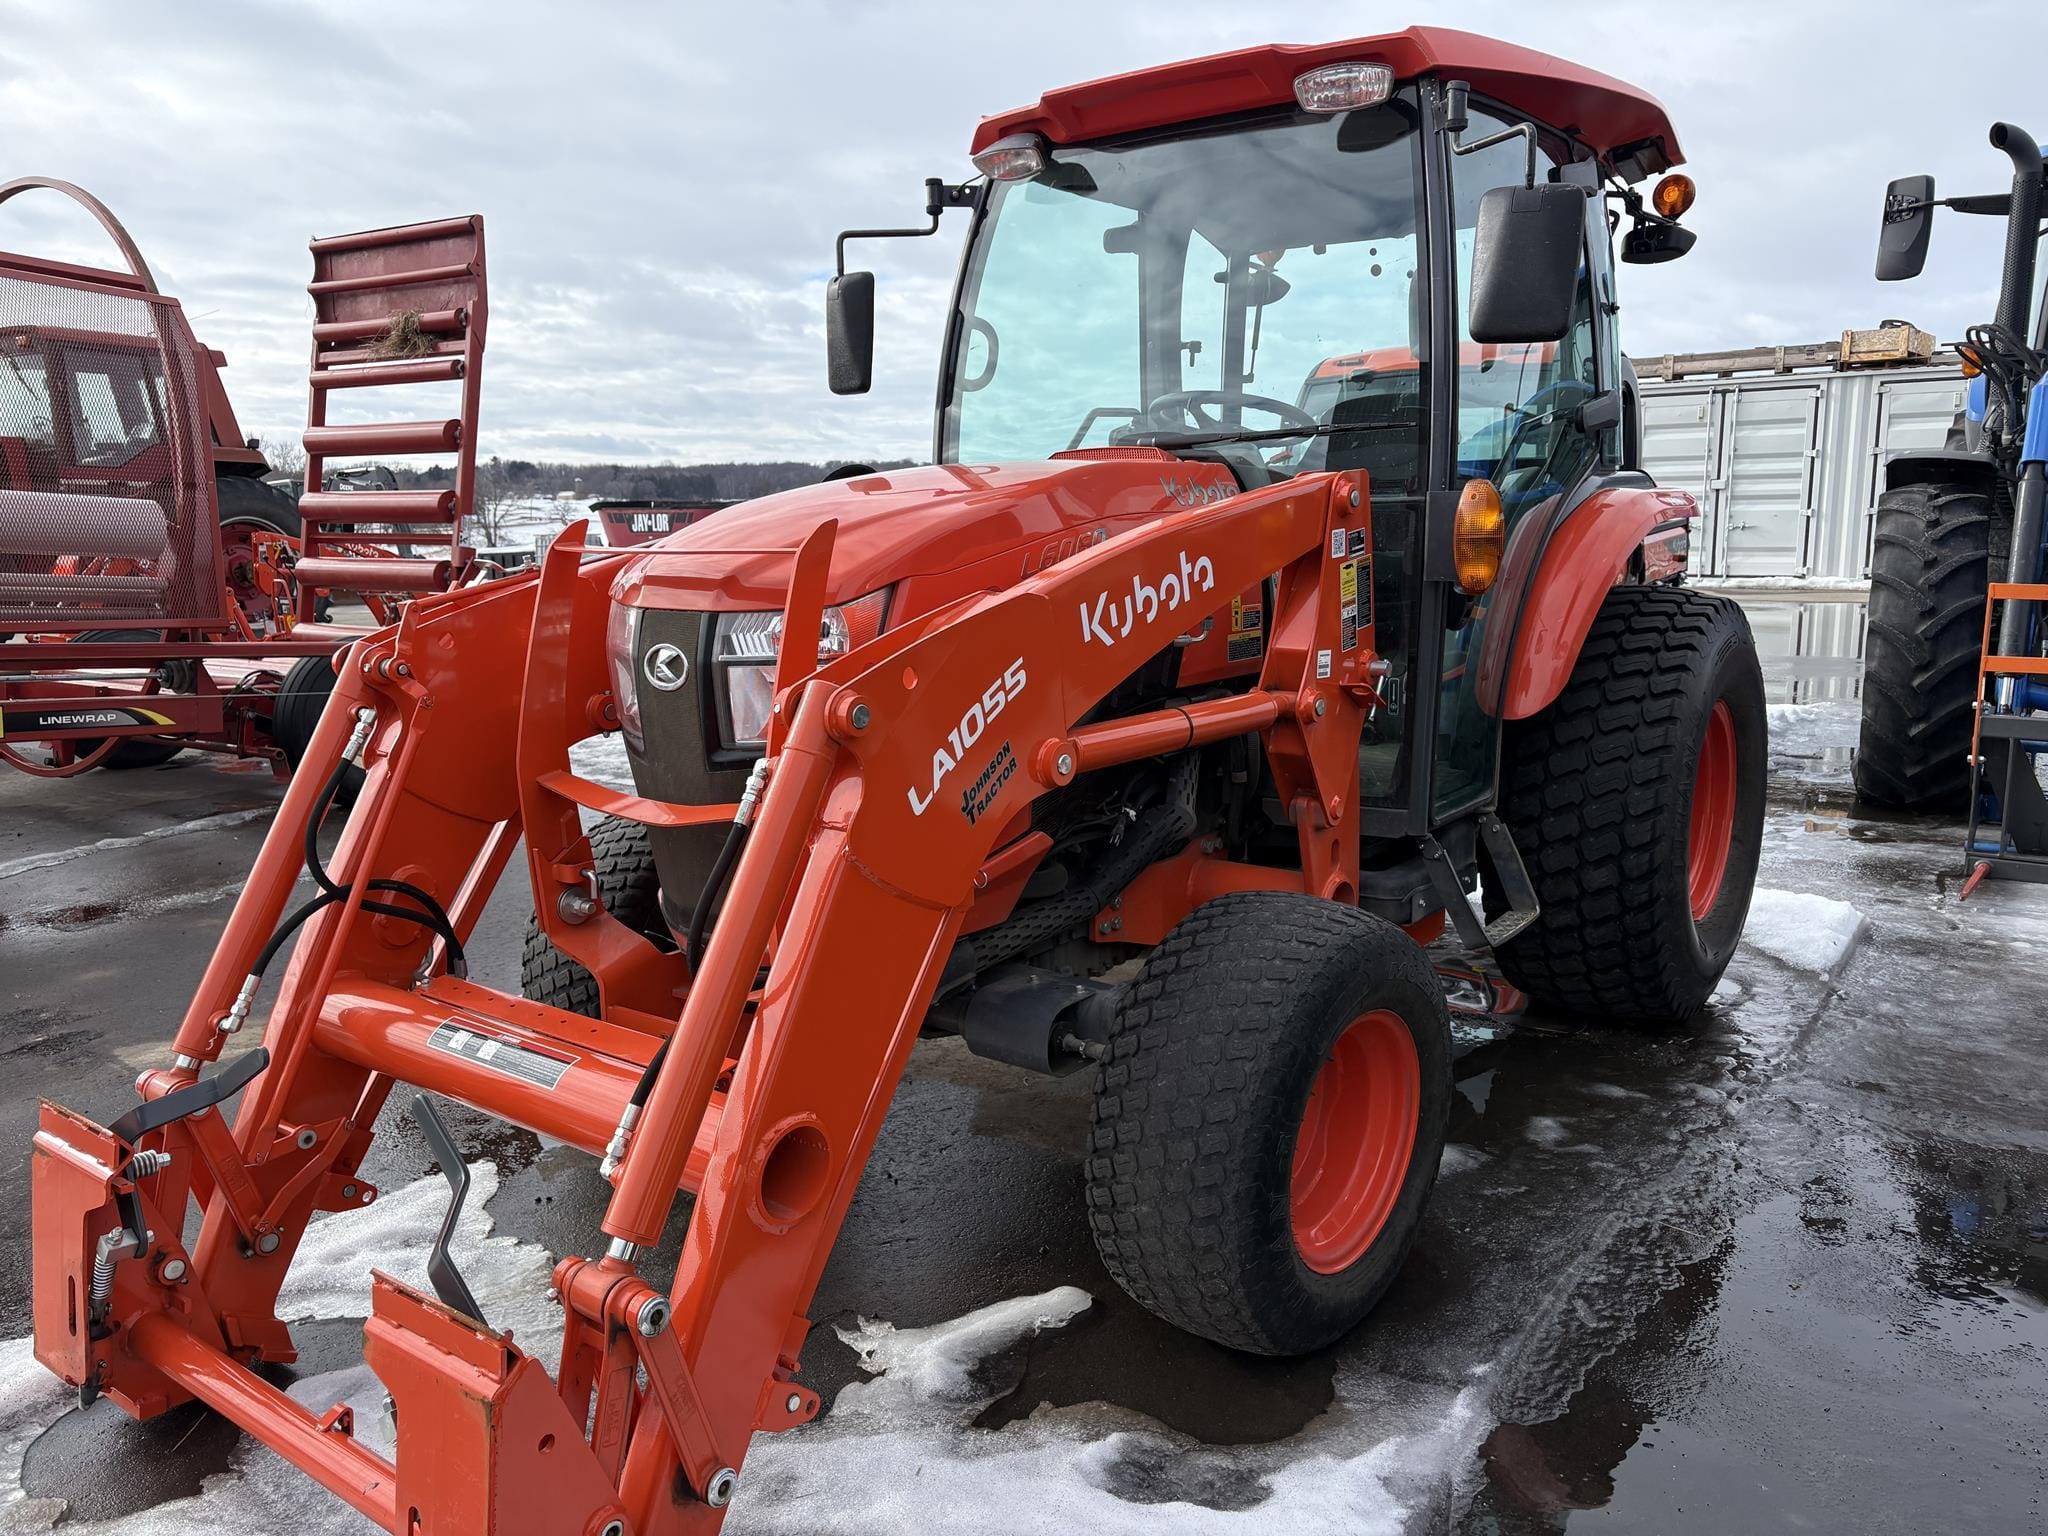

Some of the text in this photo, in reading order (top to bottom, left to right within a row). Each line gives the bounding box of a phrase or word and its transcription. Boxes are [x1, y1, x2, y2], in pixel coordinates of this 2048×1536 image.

[1160, 476, 1239, 506] Kubota
[1079, 550, 1215, 647] Kubota
[39, 713, 117, 725] LINEWRAP
[907, 656, 1027, 816] LA1055
[961, 739, 1012, 814] JOHNSON
[965, 757, 1018, 827] TRACTOR
